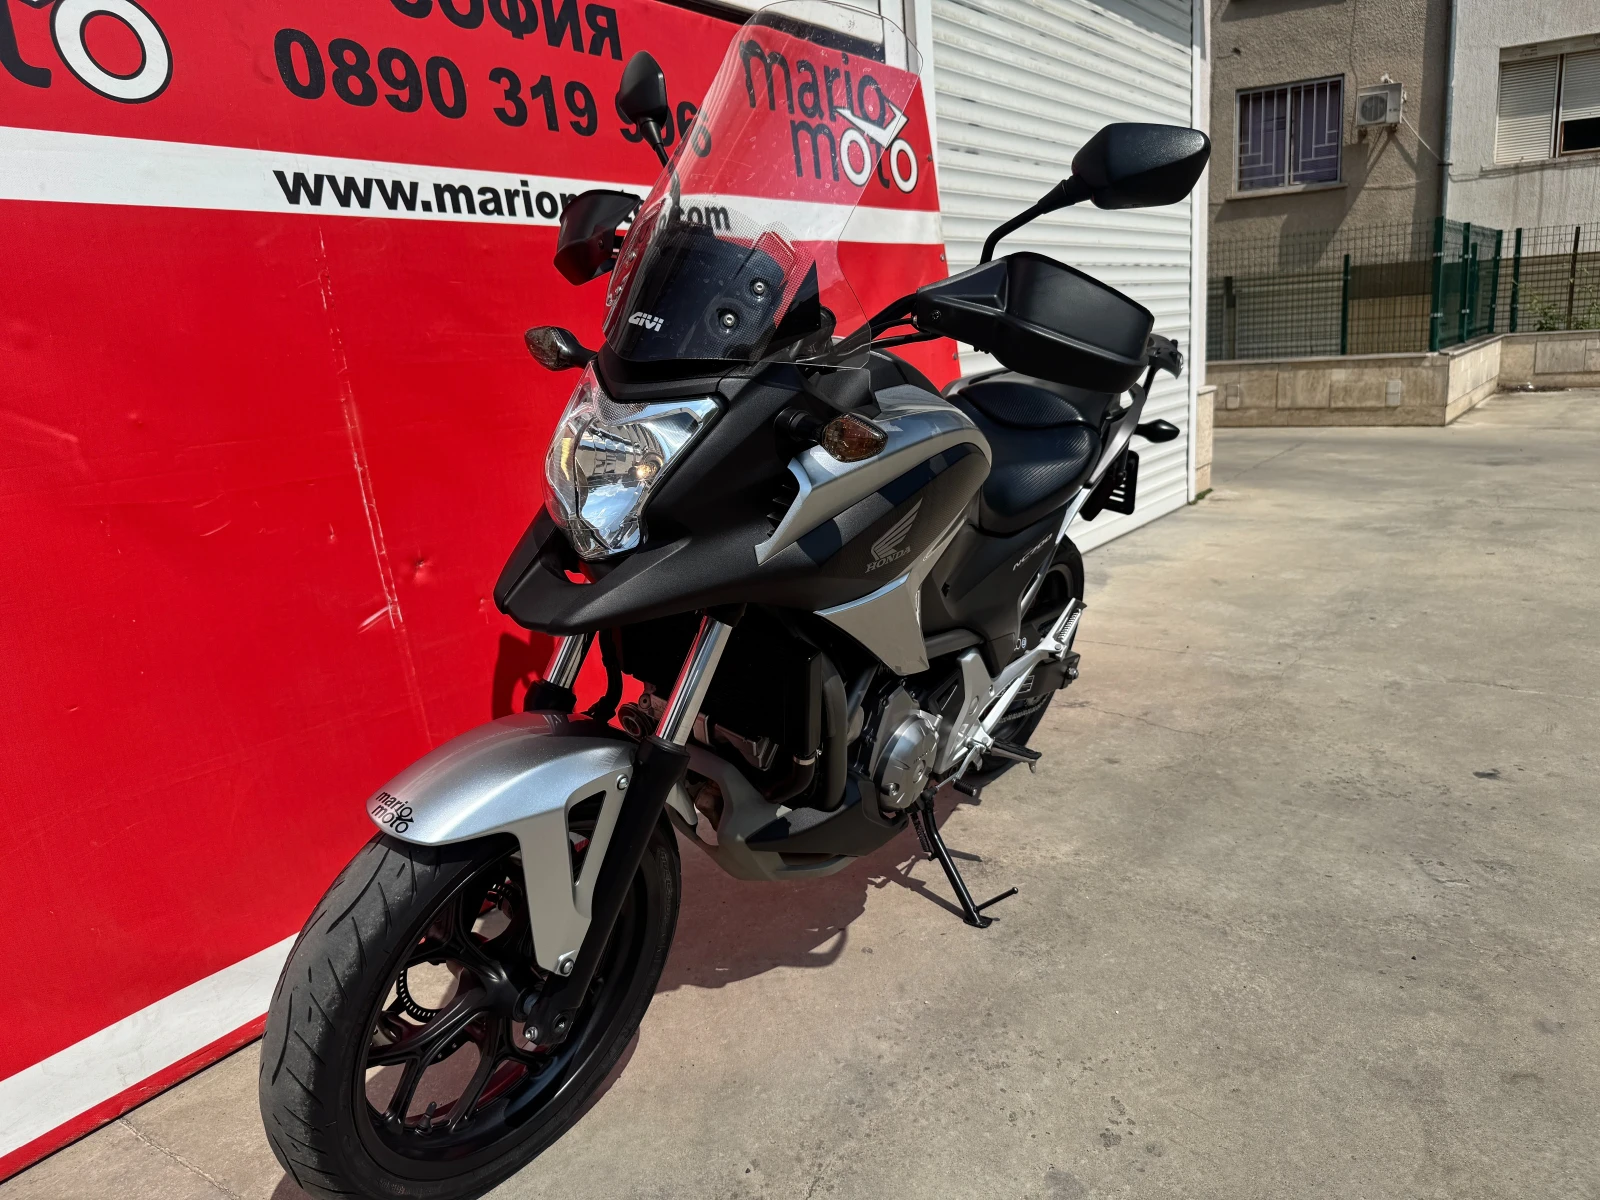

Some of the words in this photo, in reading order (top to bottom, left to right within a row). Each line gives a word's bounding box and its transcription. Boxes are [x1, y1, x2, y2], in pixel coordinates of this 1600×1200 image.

[274, 28, 467, 119] 0890
[488, 67, 598, 137] 319
[739, 39, 886, 123] mario
[790, 118, 918, 194] moto
[628, 311, 665, 332] GIVI
[865, 546, 911, 573] HONDA
[371, 804, 409, 834] moto
[376, 791, 413, 818] mario
